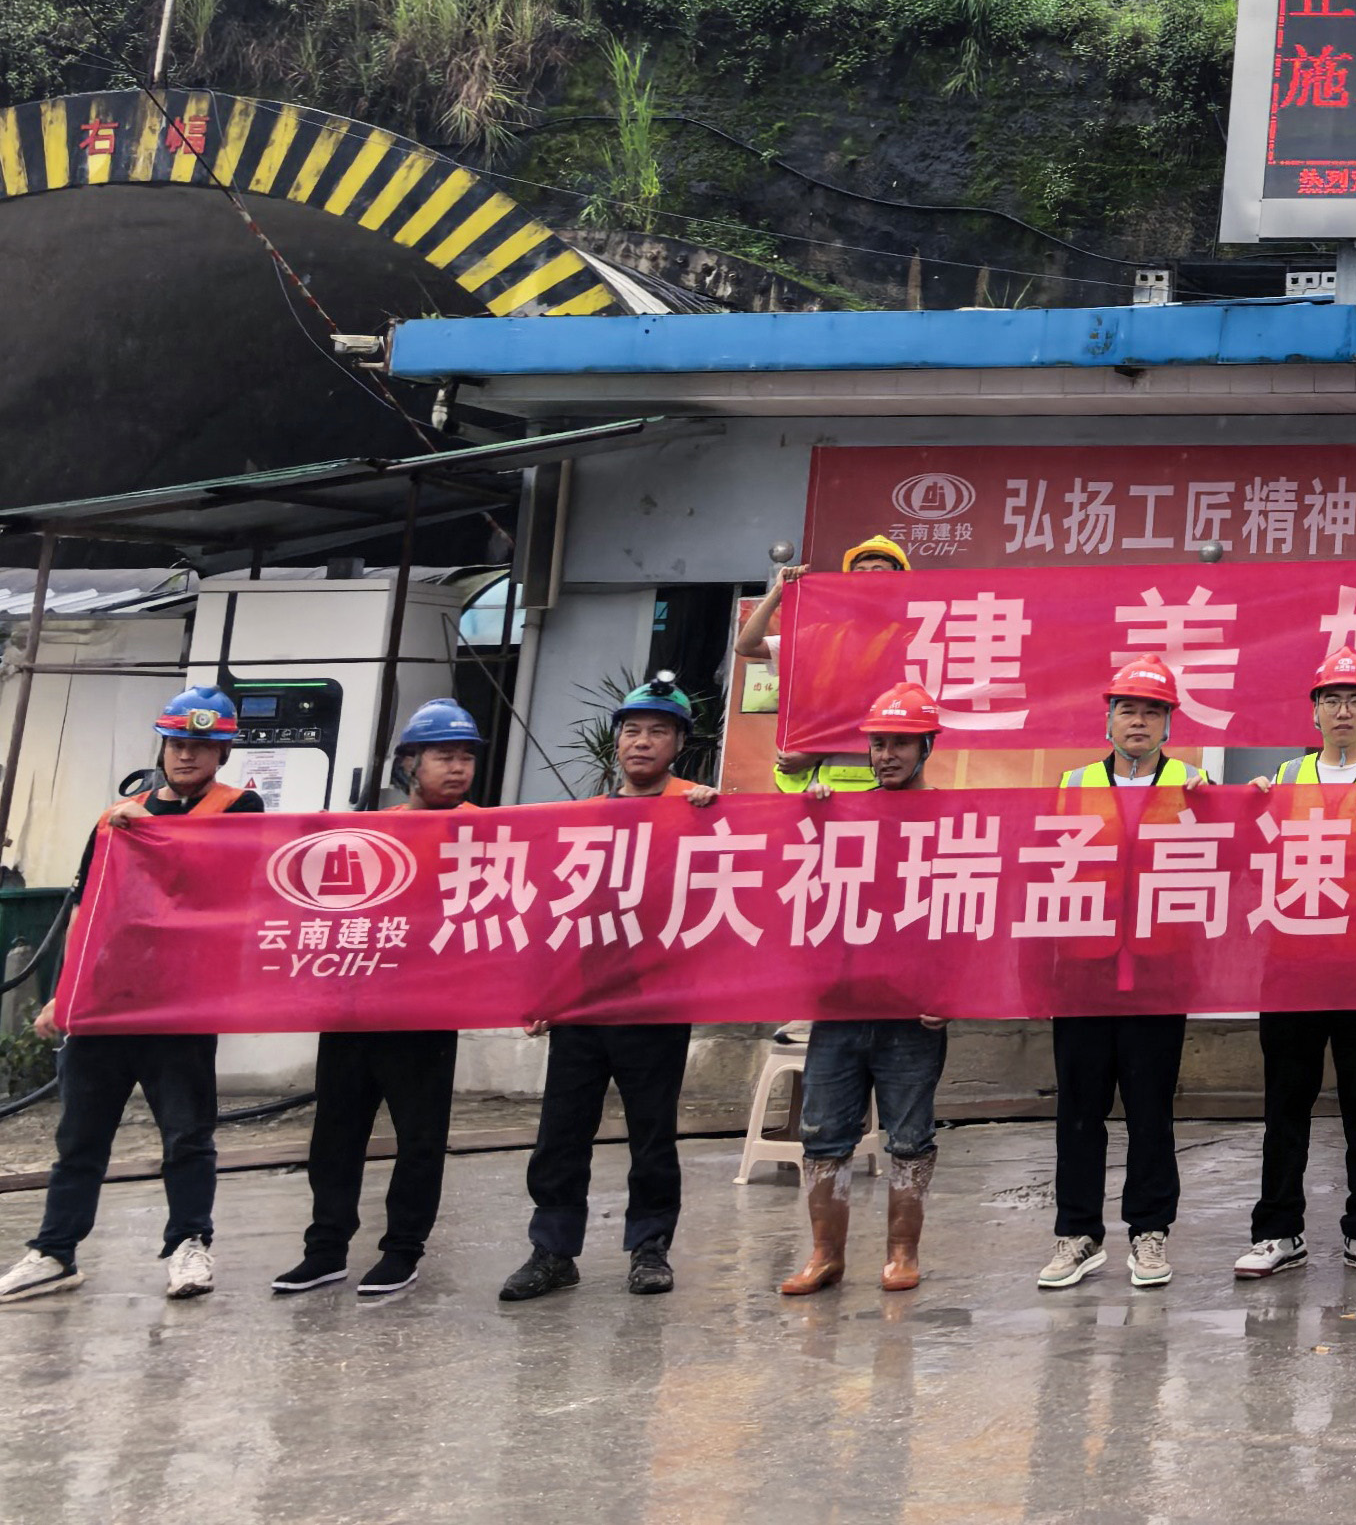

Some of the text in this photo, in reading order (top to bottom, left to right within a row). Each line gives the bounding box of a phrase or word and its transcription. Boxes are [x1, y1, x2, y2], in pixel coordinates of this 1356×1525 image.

[80, 115, 209, 156] 右幅
[889, 522, 973, 541] 云南建投
[1004, 477, 1356, 555] 弘扬工匠精神
[257, 916, 410, 950] 云南建投
